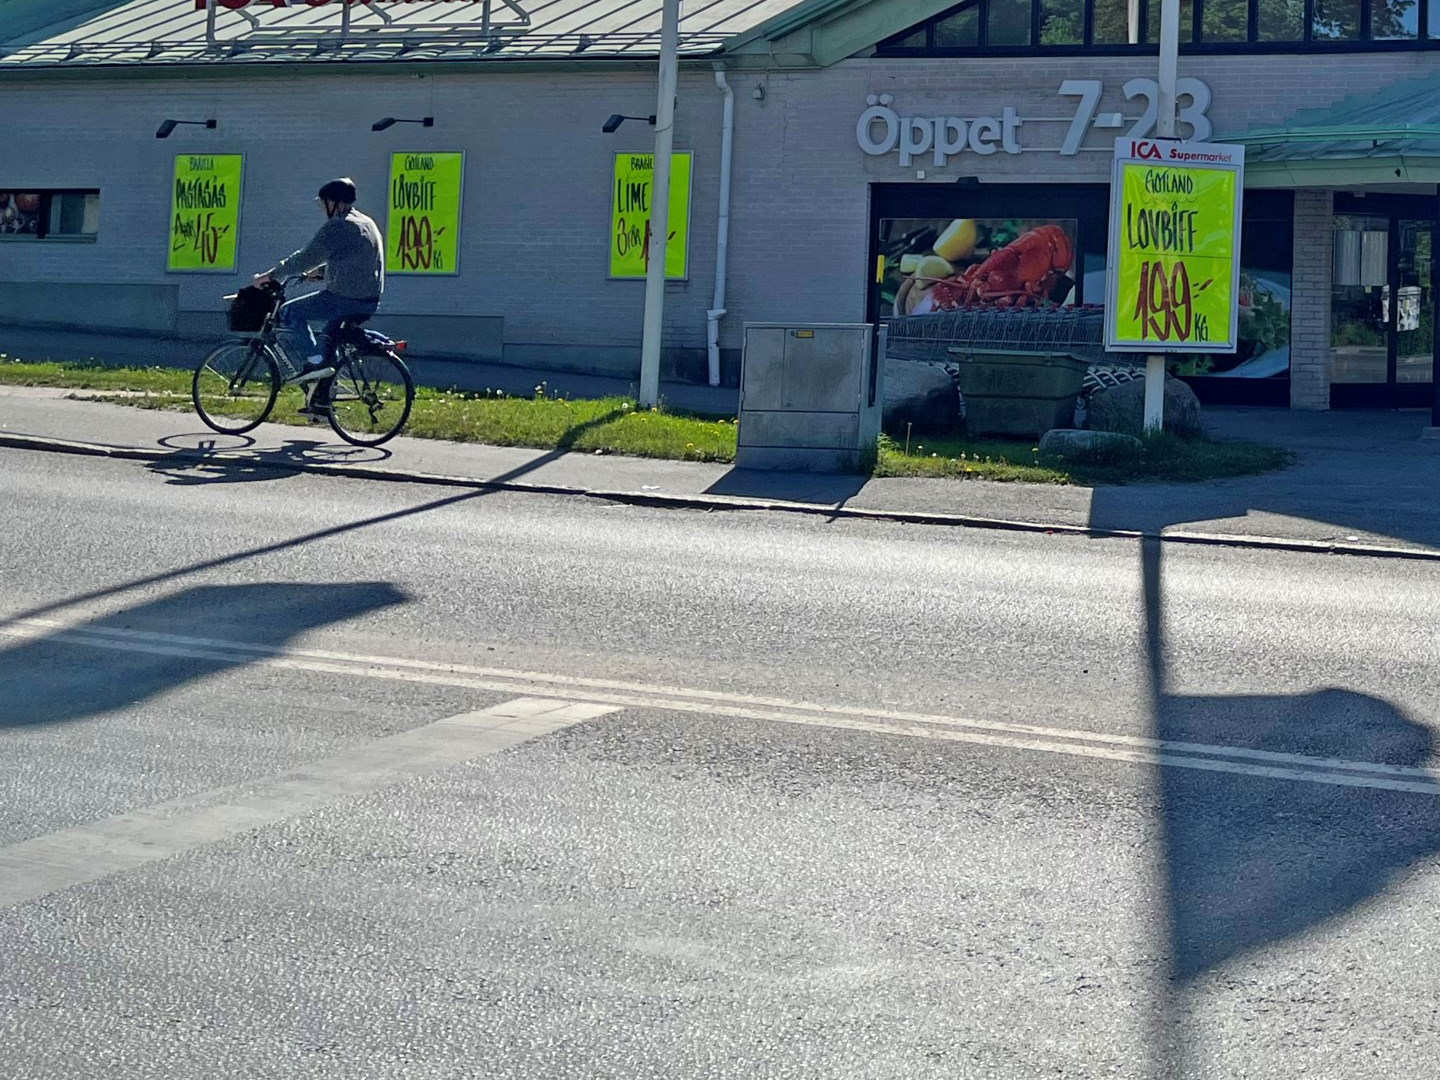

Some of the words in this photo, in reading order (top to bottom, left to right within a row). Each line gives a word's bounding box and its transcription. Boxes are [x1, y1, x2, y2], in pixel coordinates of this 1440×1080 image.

[856, 93, 1023, 167] Öppet
[1057, 77, 1213, 156] 7-23
[1131, 140, 1163, 160] ICA
[1169, 148, 1233, 162] Supermarket
[1145, 169, 1194, 195] GOTLAND
